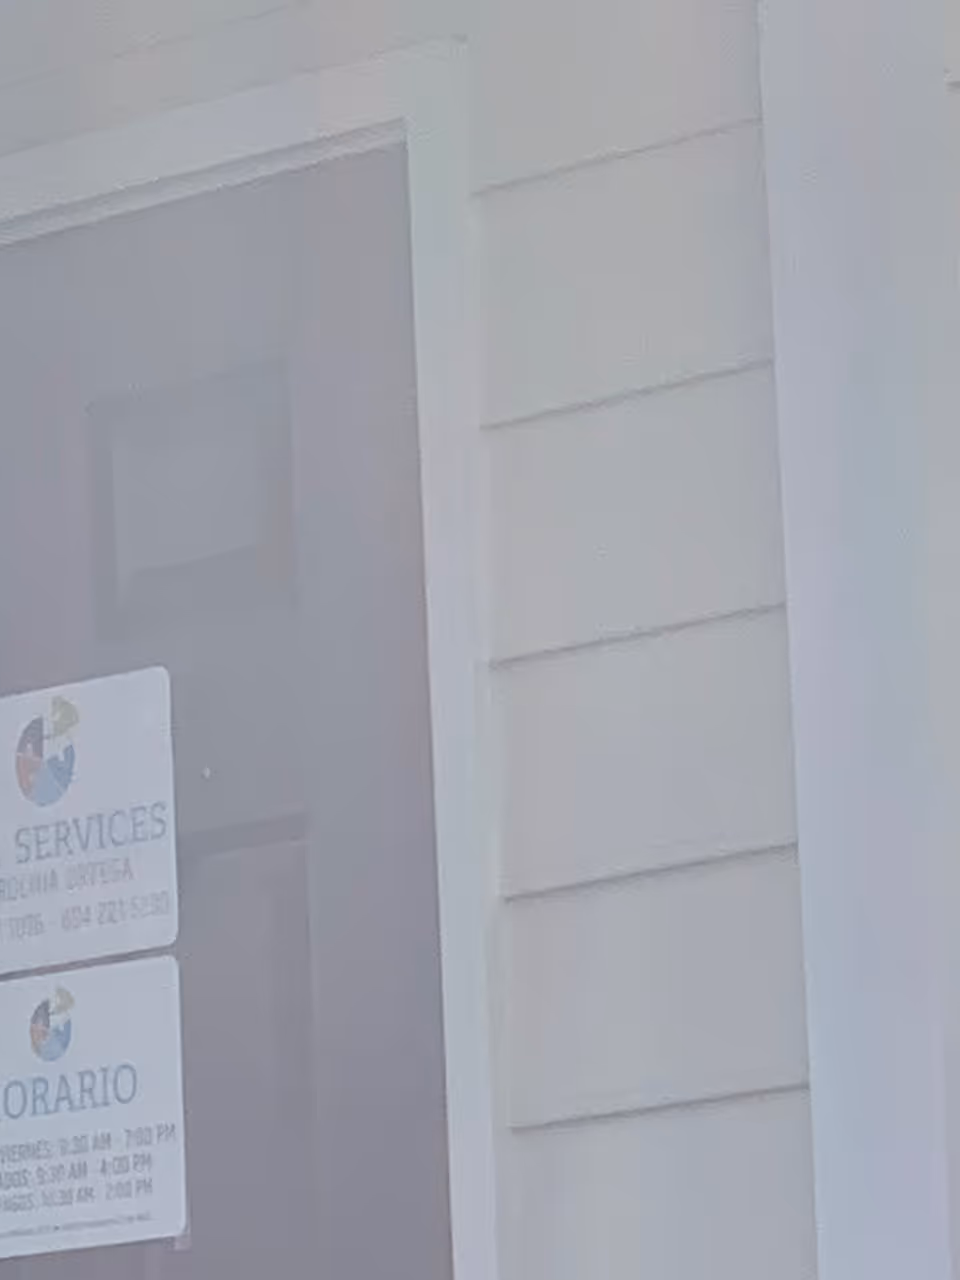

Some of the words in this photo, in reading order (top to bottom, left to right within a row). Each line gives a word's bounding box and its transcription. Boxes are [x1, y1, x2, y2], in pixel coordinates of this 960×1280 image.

[15, 801, 167, 864] SERVICES
[156, 1123, 177, 1144] PM
[133, 1153, 152, 1171] PM
